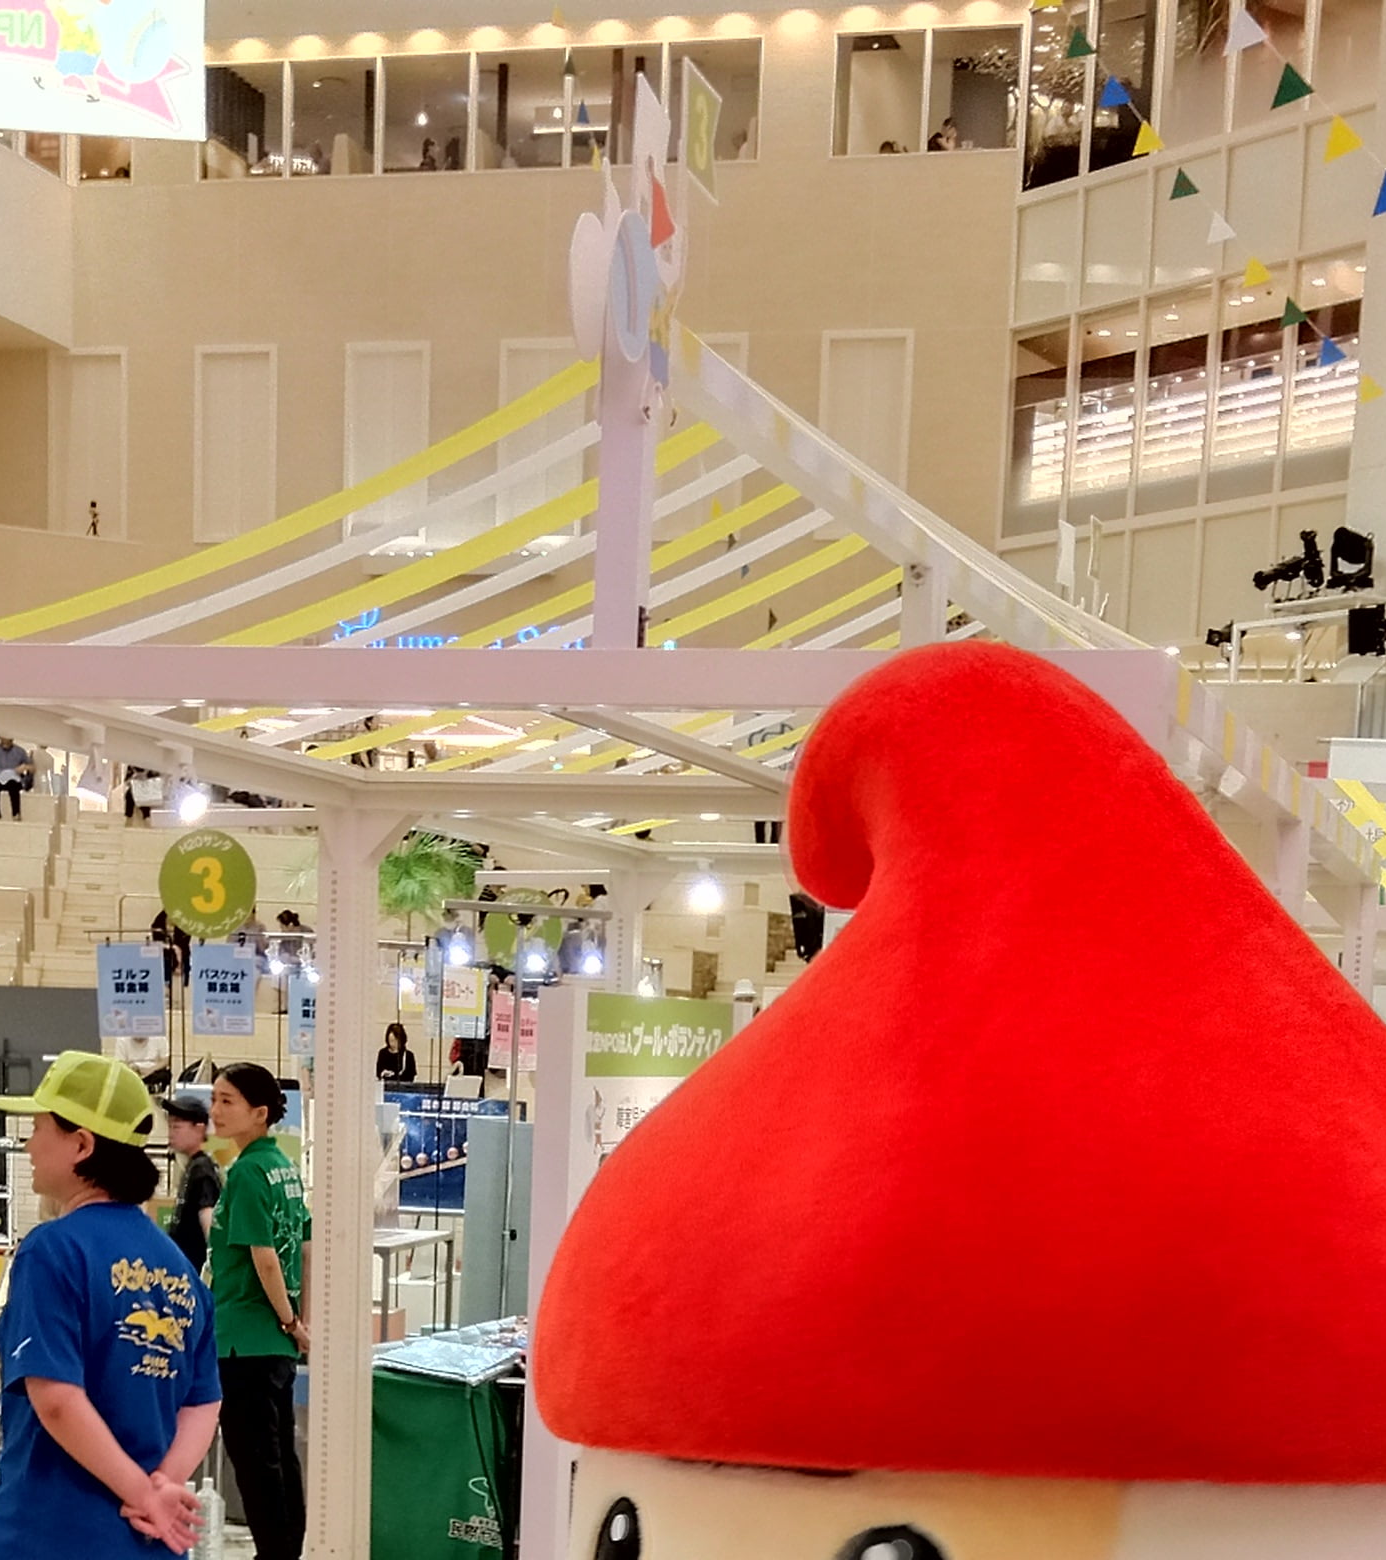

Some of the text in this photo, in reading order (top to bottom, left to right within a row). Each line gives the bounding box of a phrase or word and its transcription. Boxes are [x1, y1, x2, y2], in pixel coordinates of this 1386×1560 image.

[189, 856, 227, 914] 3
[111, 968, 151, 981] ゴルフ
[198, 968, 249, 981] バスケット
